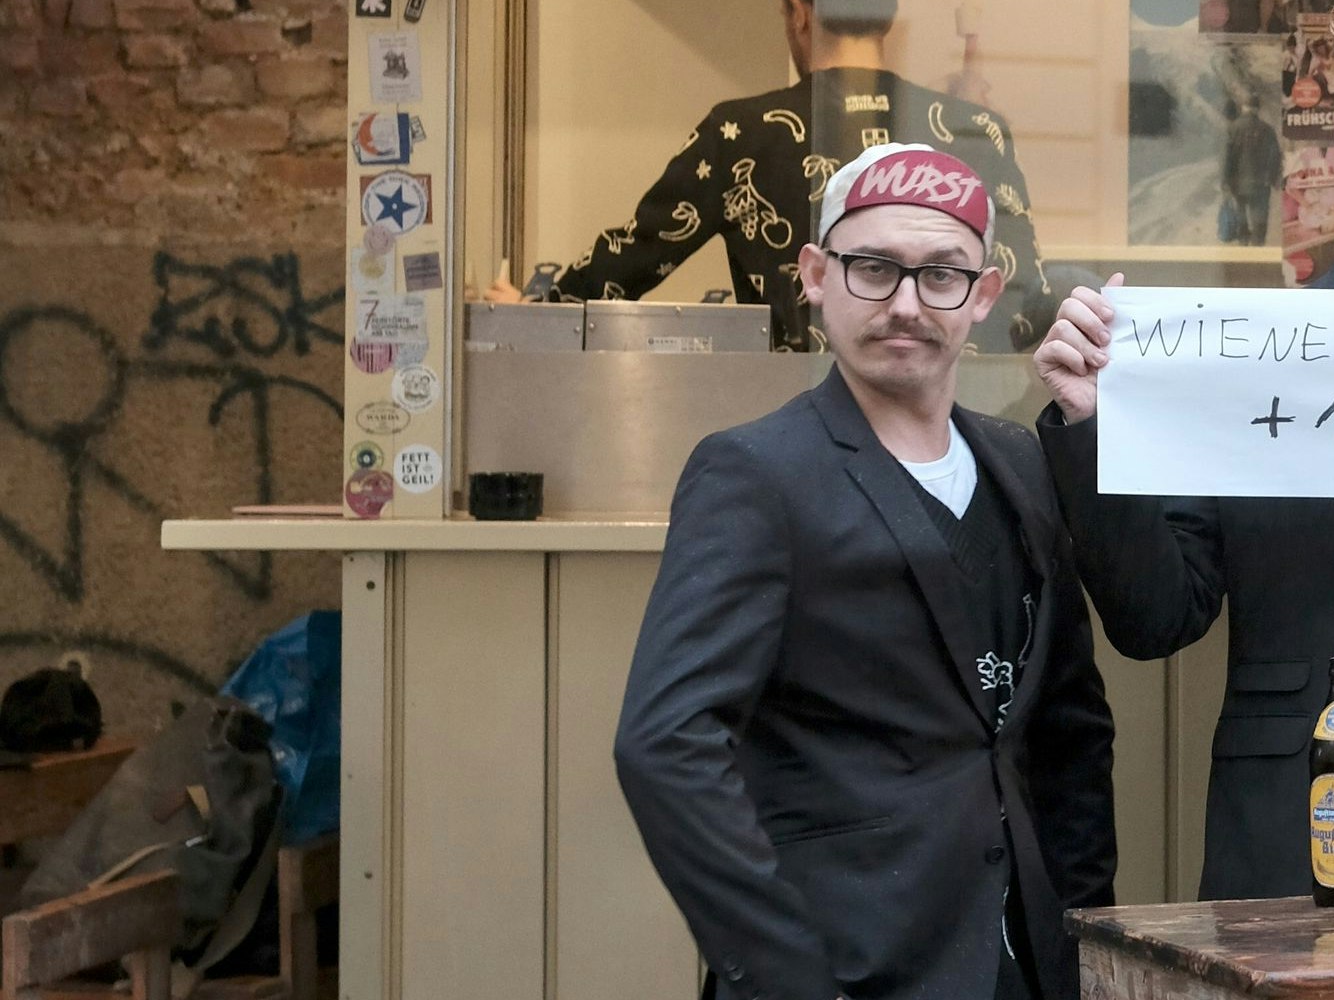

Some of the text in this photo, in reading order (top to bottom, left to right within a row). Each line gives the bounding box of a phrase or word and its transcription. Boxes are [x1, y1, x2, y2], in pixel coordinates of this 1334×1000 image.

[859, 159, 983, 208] WURST
[401, 452, 430, 463] FETT
[401, 463, 419, 474] IST
[401, 474, 434, 485] GEIL!
